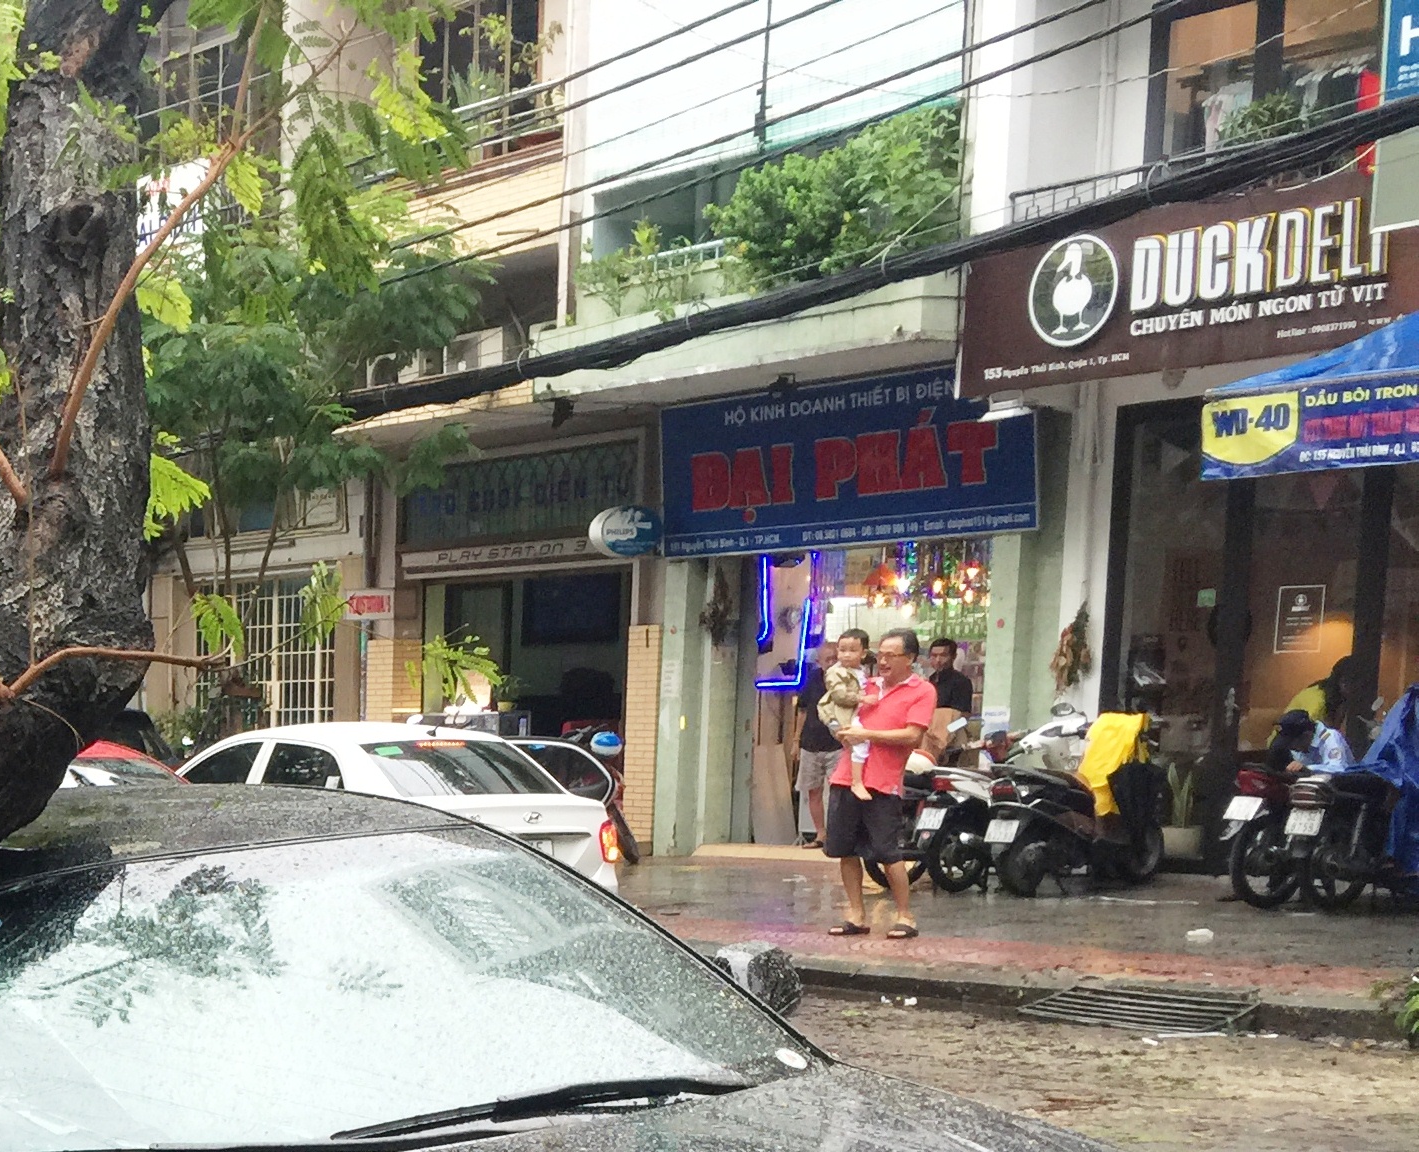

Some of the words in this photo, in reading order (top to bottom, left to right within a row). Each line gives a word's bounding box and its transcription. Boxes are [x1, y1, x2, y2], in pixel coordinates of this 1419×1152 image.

[1130, 308, 1204, 336] CHUYÊN
[1209, 300, 1253, 325] MÓN
[1258, 293, 1312, 317] NGON
[1318, 284, 1347, 307] TỪ
[1351, 282, 1386, 308] VỊT
[984, 367, 1002, 380] 153
[724, 404, 747, 427] HỘ
[750, 402, 785, 422] KINH
[789, 395, 846, 417] DOANH
[849, 383, 892, 410] THIẾT
[895, 385, 911, 405] BỊ
[1305, 388, 1337, 408] DẦU
[1342, 386, 1371, 402] BÔI
[1374, 383, 1418, 400] TRƠN
[1212, 402, 1290, 438] WD-40
[690, 442, 795, 524] ĐẠI
[814, 405, 999, 502] PHÁT
[605, 527, 636, 537] PHILIPS
[437, 550, 481, 564] PLAY
[573, 539, 588, 552] 3
